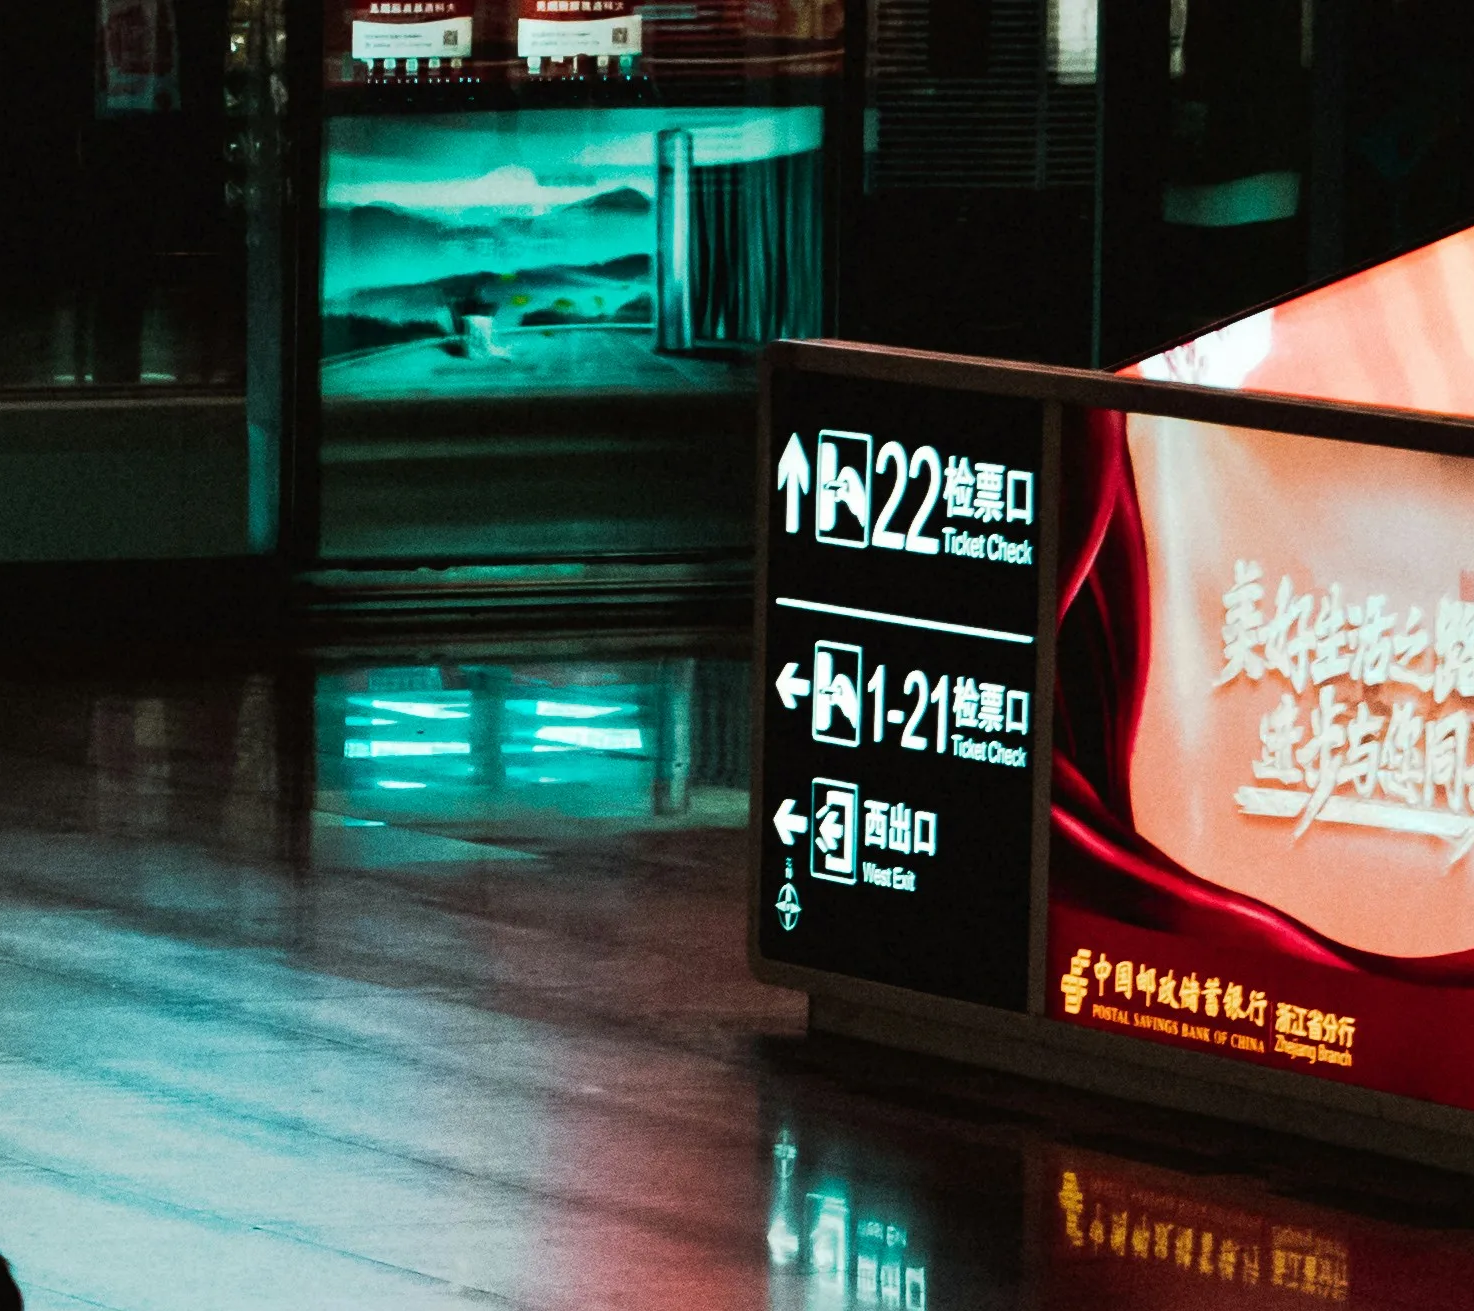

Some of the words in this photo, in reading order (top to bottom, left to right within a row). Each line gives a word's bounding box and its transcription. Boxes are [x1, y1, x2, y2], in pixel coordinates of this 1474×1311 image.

[872, 441, 943, 555] 22
[943, 455, 1034, 525] 检票口
[942, 527, 985, 559] Ticket
[987, 533, 1033, 565] Check
[867, 664, 950, 754] 1-21
[952, 676, 1030, 735] 检票口
[951, 734, 987, 762] Ticket
[988, 739, 1028, 768] Check
[863, 800, 938, 856] 西出口
[862, 861, 892, 888] West
[892, 866, 917, 892] Exit
[1093, 952, 1268, 1027] 中国邮政储蓄银行
[1092, 1003, 1131, 1027] POSTAL
[1133, 1012, 1178, 1035] SAVINGS
[1181, 1022, 1210, 1043] BANK
[1213, 1030, 1228, 1045] OF
[1230, 1033, 1265, 1054] CHINA
[1274, 1002, 1356, 1048] 浙江省分行
